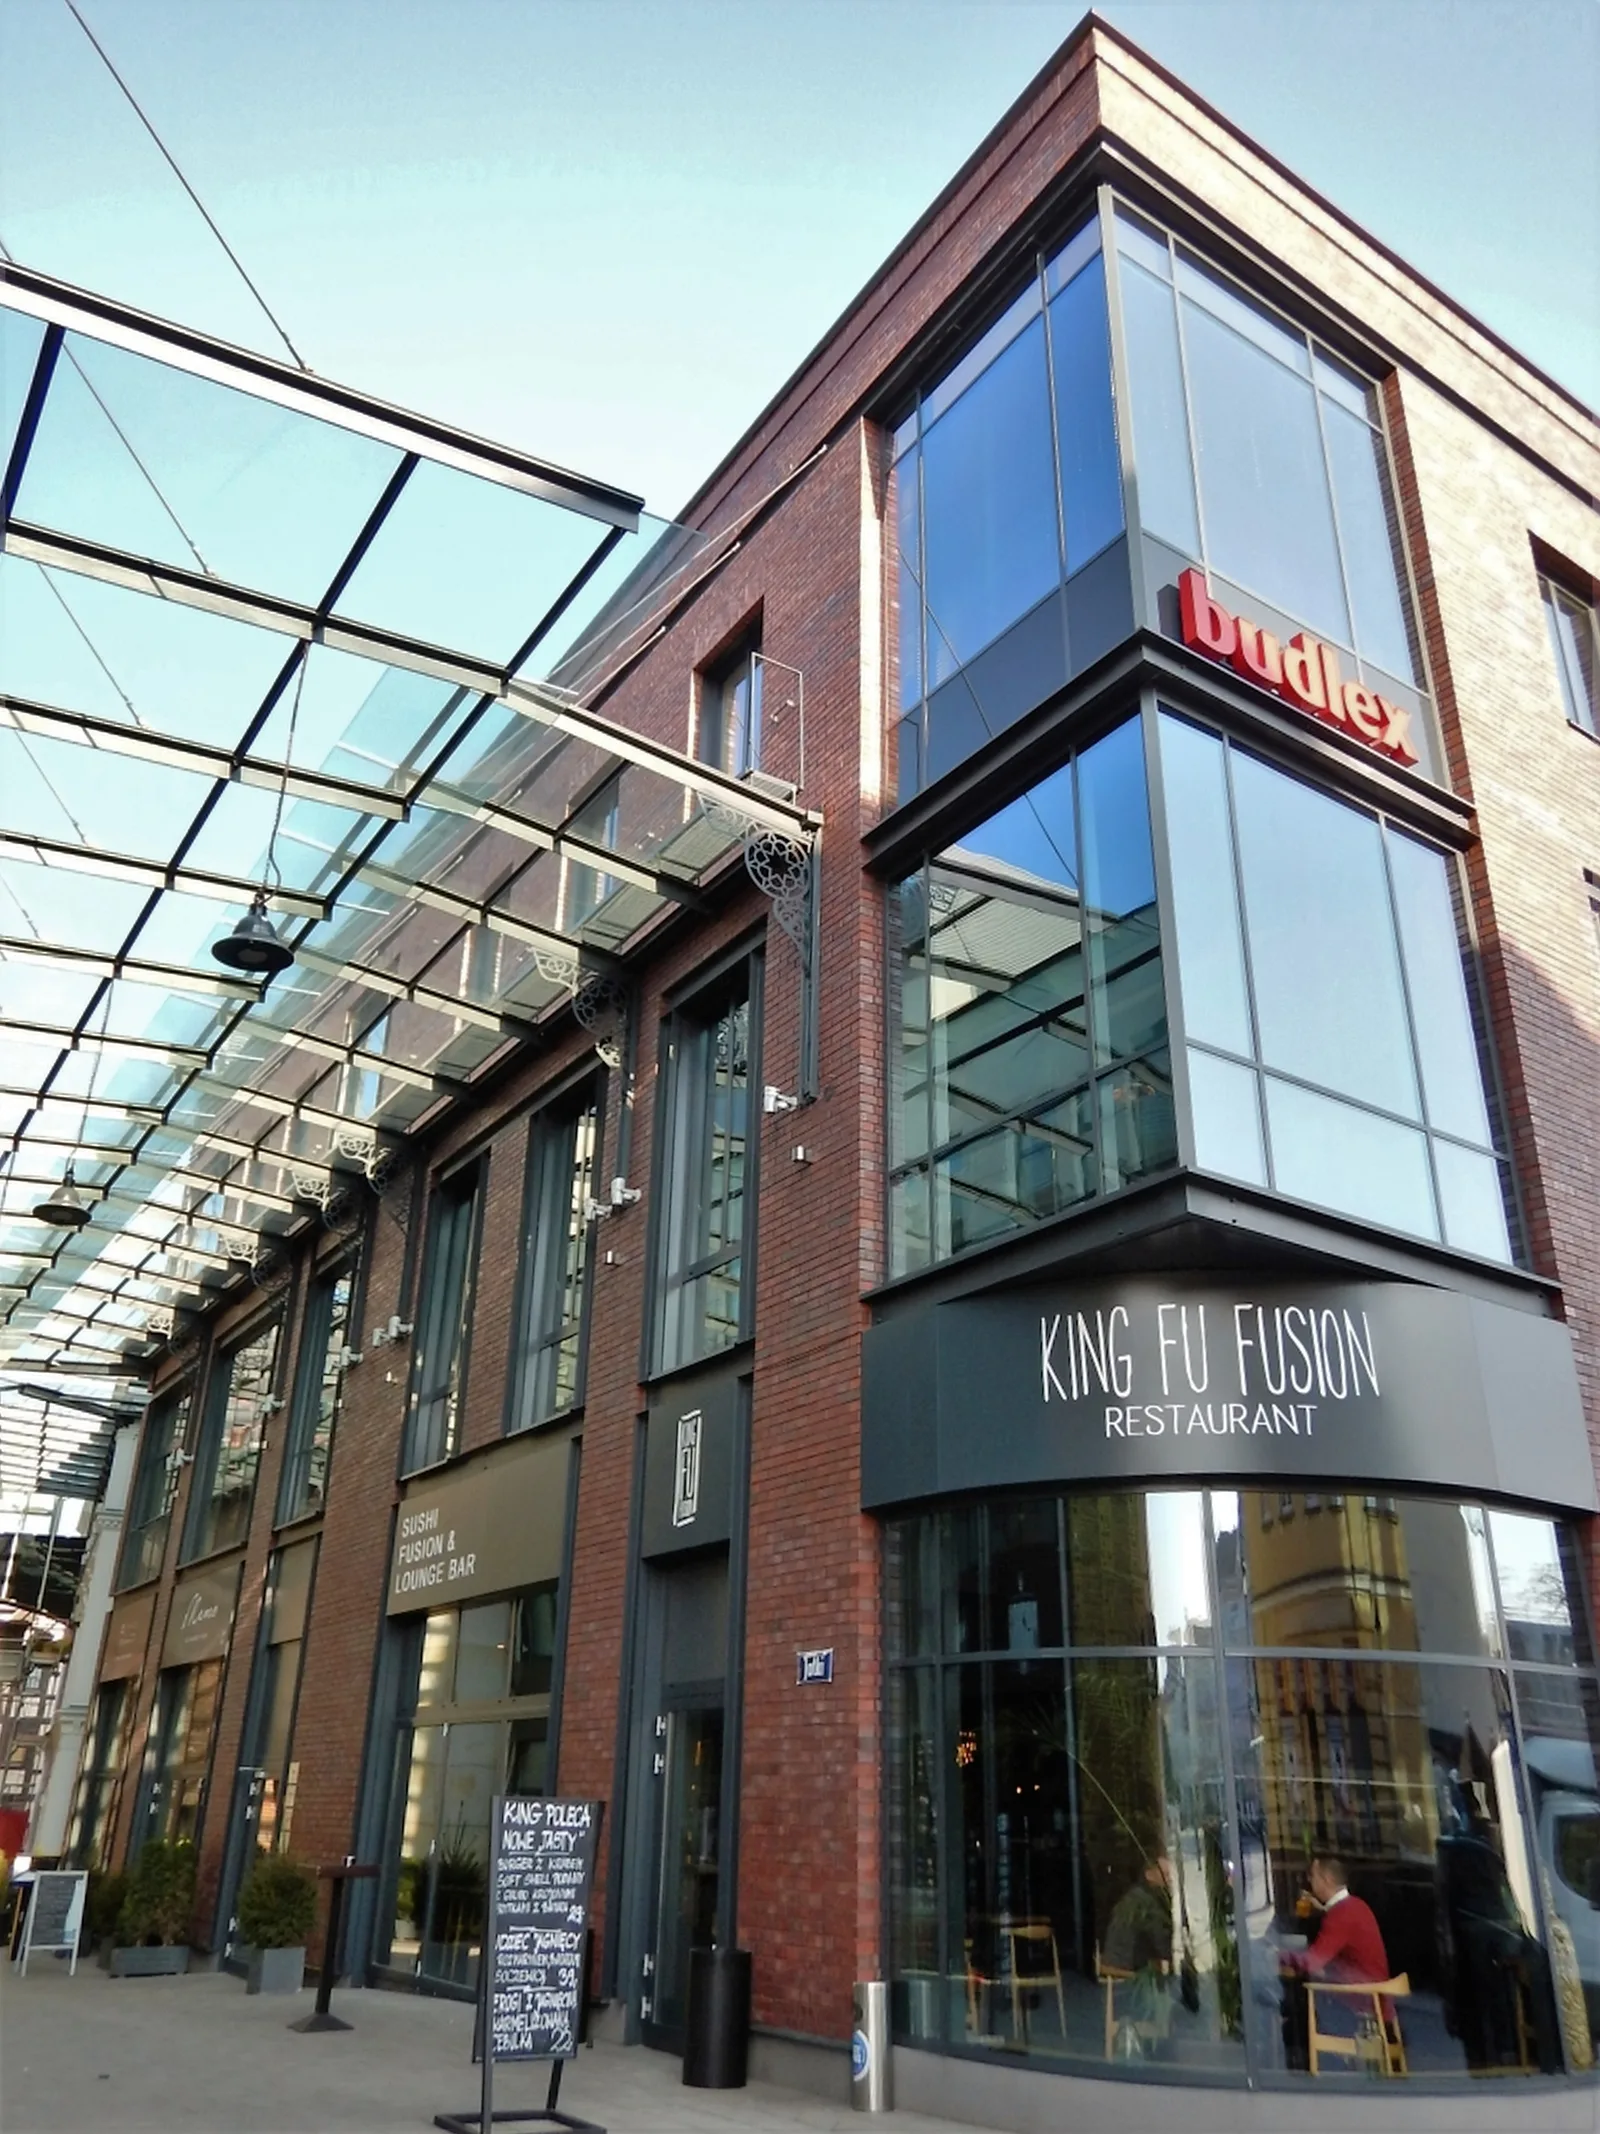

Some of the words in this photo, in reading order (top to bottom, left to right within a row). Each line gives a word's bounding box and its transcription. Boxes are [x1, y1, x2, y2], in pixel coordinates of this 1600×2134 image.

[1178, 567, 1418, 768] budlex
[1040, 1305, 1133, 1403] KING
[1157, 1303, 1208, 1397] FU
[1234, 1303, 1381, 1400] FUSION
[1104, 1404, 1318, 1438] RESTAURANT
[401, 1508, 439, 1538] SUSHI
[398, 1533, 444, 1566] FUSION
[447, 1530, 456, 1551] &
[395, 1561, 446, 1594] LOUNGE
[447, 1553, 477, 1581] BAR
[503, 1801, 543, 1826] KING
[545, 1803, 591, 1828] POLECA
[502, 1830, 535, 1850] NOWE
